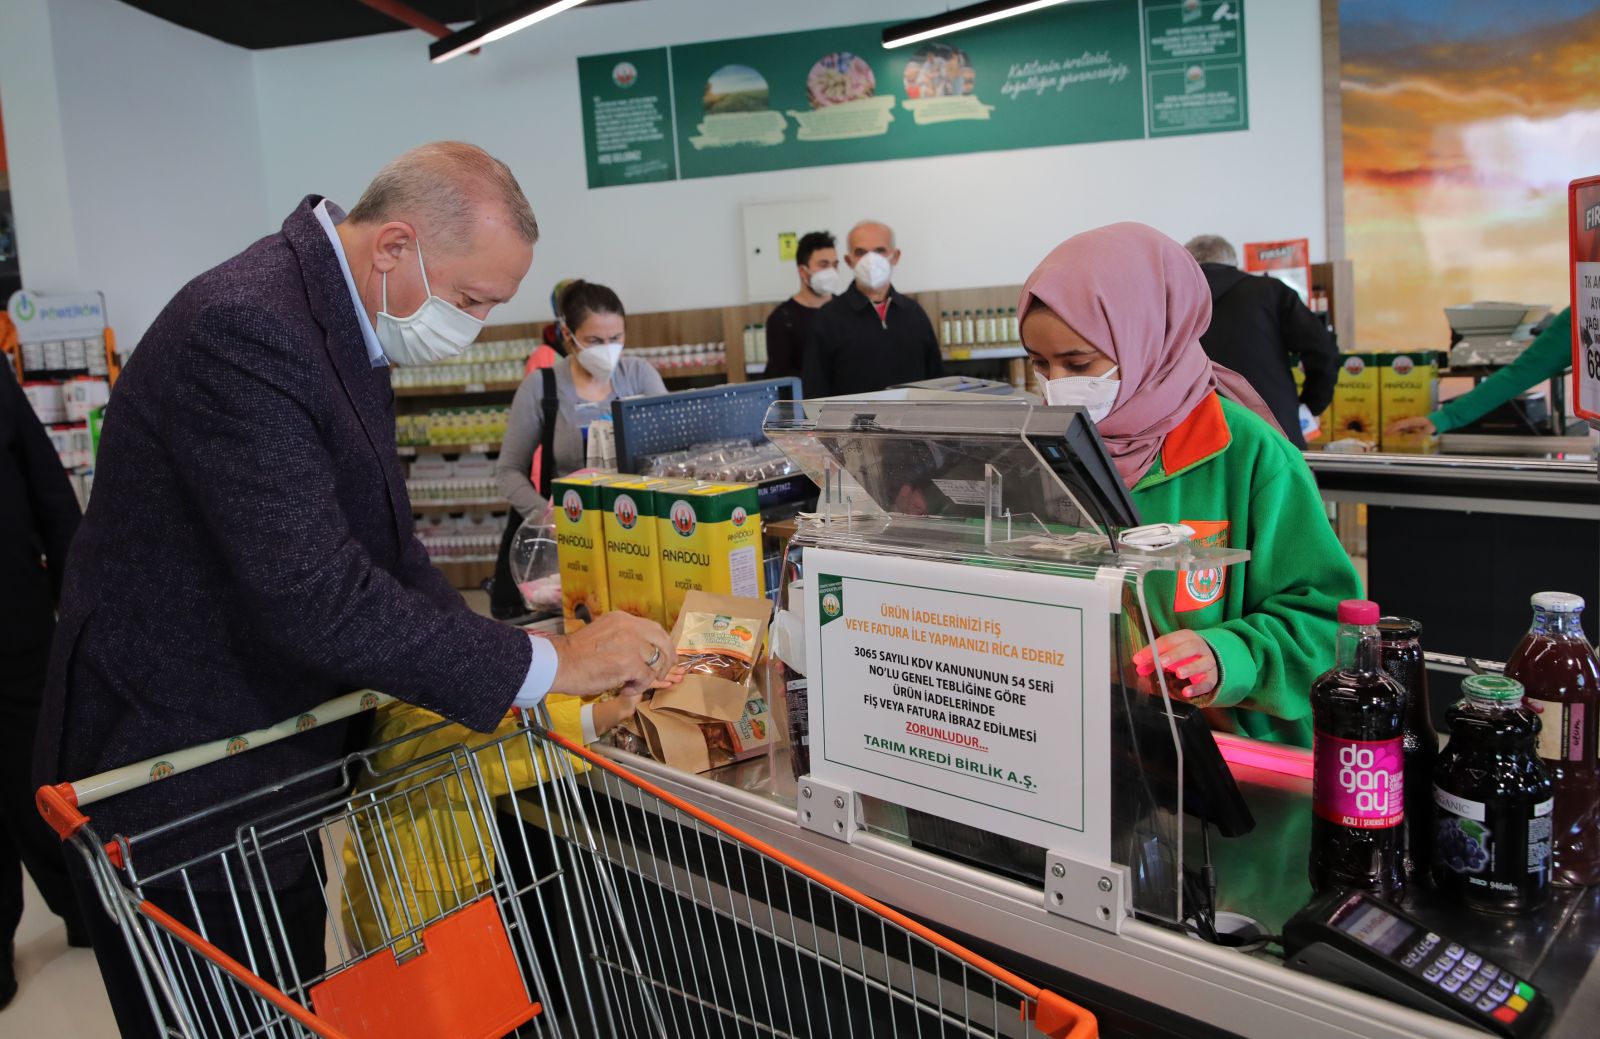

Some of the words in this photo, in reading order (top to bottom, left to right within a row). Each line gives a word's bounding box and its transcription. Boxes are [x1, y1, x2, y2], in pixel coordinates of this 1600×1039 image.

[1593, 274, 1600, 289] A
[1591, 296, 1600, 310] AY
[558, 533, 593, 549] ANADOLU
[608, 540, 650, 557] ANADOLU
[662, 549, 710, 567] ANADOLU
[881, 602, 909, 620] ÜRÜN
[912, 607, 982, 633] İADELERİNİZİ
[985, 619, 1001, 638] FİŞ
[846, 618, 869, 633] VEYE
[872, 622, 910, 640] FATURA
[912, 626, 928, 643] İLE
[929, 631, 989, 654] YAPMANIZI
[992, 640, 1019, 659] RİCA
[1021, 647, 1065, 667] EDERİZ
[854, 646, 877, 660] 3065
[880, 650, 909, 666] SAYILI
[912, 656, 933, 670] KDV
[936, 661, 1009, 685] KANUNUNUN
[1011, 675, 1026, 688] 54
[1028, 678, 1054, 694] SERİ
[893, 683, 922, 701] ÜRÜN
[925, 689, 995, 717] İADELERİNDE
[901, 671, 934, 687] GENEL
[936, 677, 992, 699] TEBLİĞİNE
[994, 689, 1027, 706] GÖRE
[864, 693, 878, 709] FİŞ
[880, 697, 905, 713] VEYA
[906, 704, 946, 723] FATURA
[949, 711, 981, 731] İBRAZ
[983, 721, 1037, 743] EDİLMESİ
[905, 721, 989, 750] ZORUNLUDUR...
[864, 734, 906, 754] TARIM
[909, 745, 951, 766] KREDİ
[955, 757, 1003, 780] BİRLİK
[1007, 771, 1037, 789] A.Ş.
[1340, 743, 1374, 768] do
[1356, 791, 1389, 816] ay
